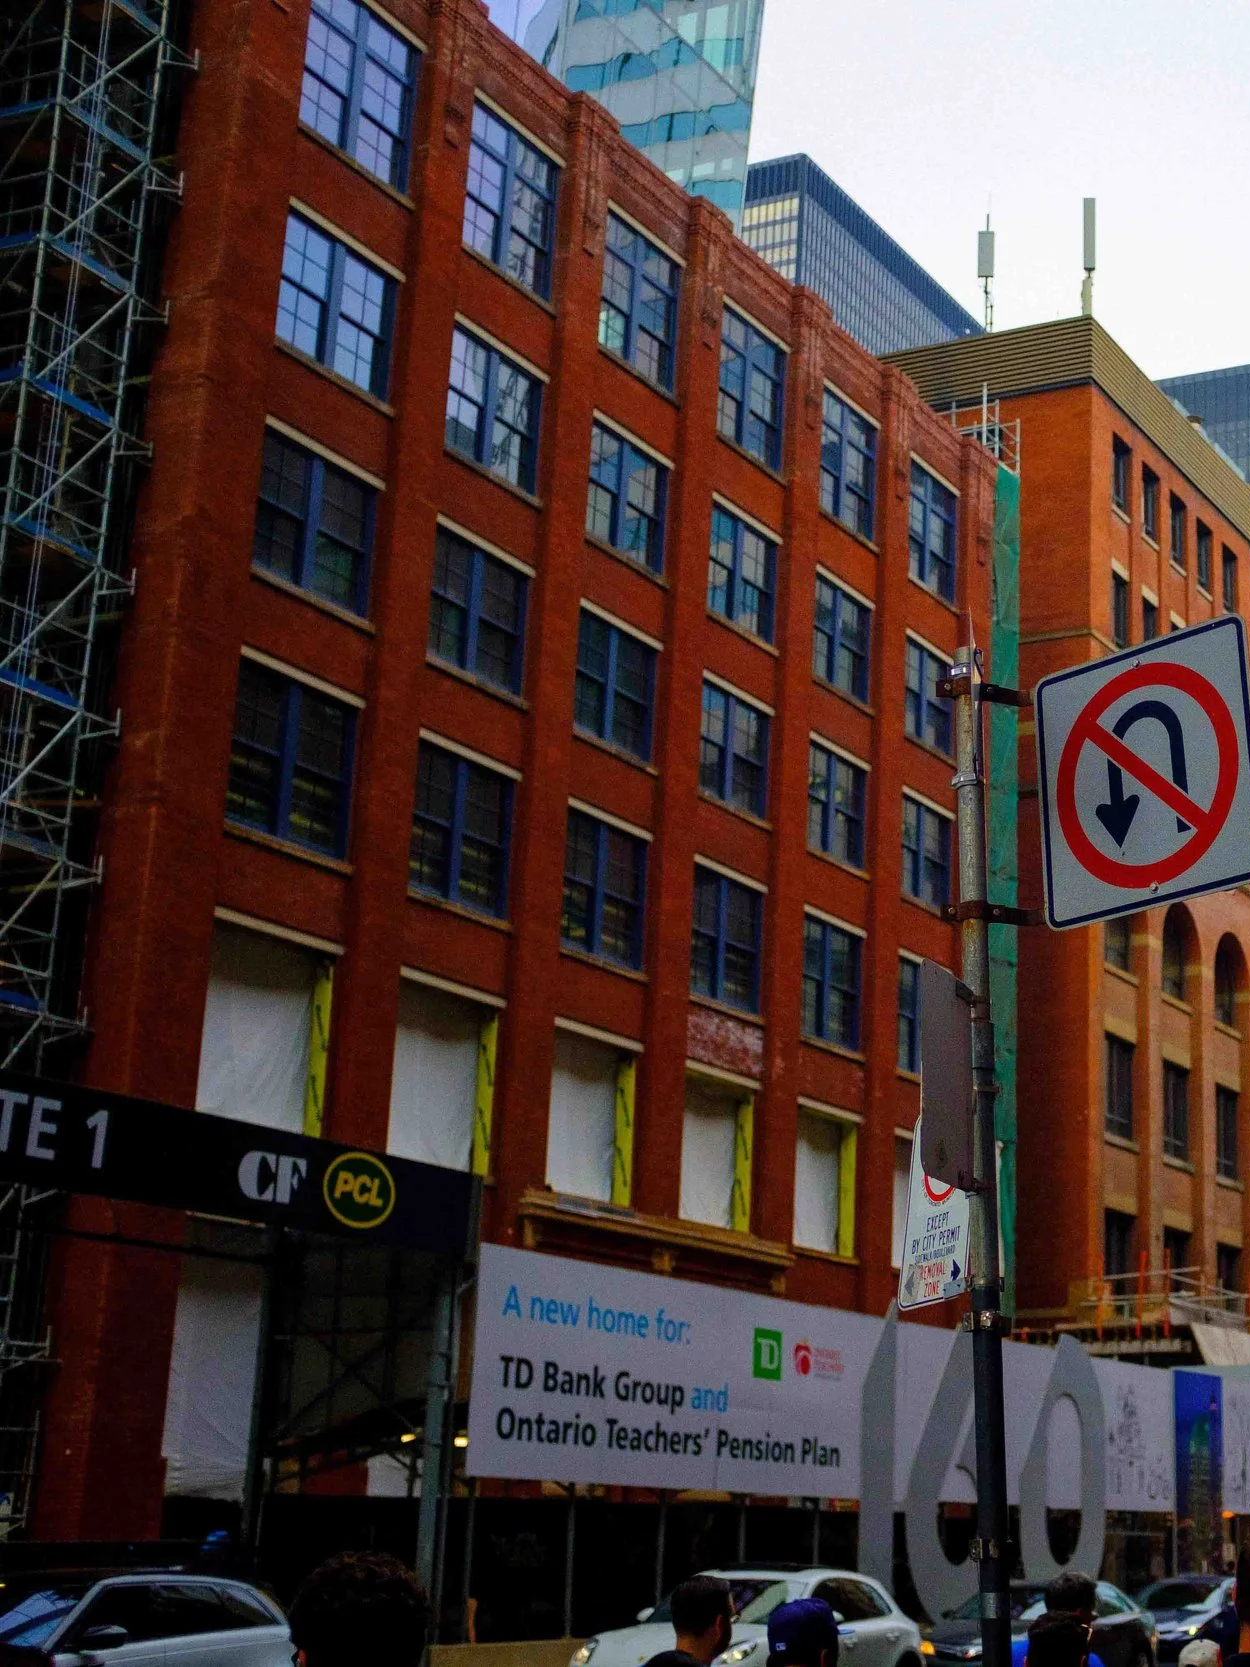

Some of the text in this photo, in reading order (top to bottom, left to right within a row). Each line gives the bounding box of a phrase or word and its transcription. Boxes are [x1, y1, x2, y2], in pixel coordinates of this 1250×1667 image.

[0, 1087, 109, 1170] TE 1
[237, 1149, 308, 1205] CF
[333, 1169, 384, 1209] PCL
[911, 1225, 961, 1254] BY CITY PERMIT
[926, 1211, 949, 1232] EXCEPT
[924, 1281, 940, 1298] ZONE
[502, 1284, 691, 1346] A new home for:
[756, 1336, 781, 1371] TD
[500, 1355, 730, 1415] TD Bank Group and
[496, 1407, 597, 1447] Ontario
[716, 1429, 795, 1464] Pension
[801, 1436, 841, 1468] Plan
